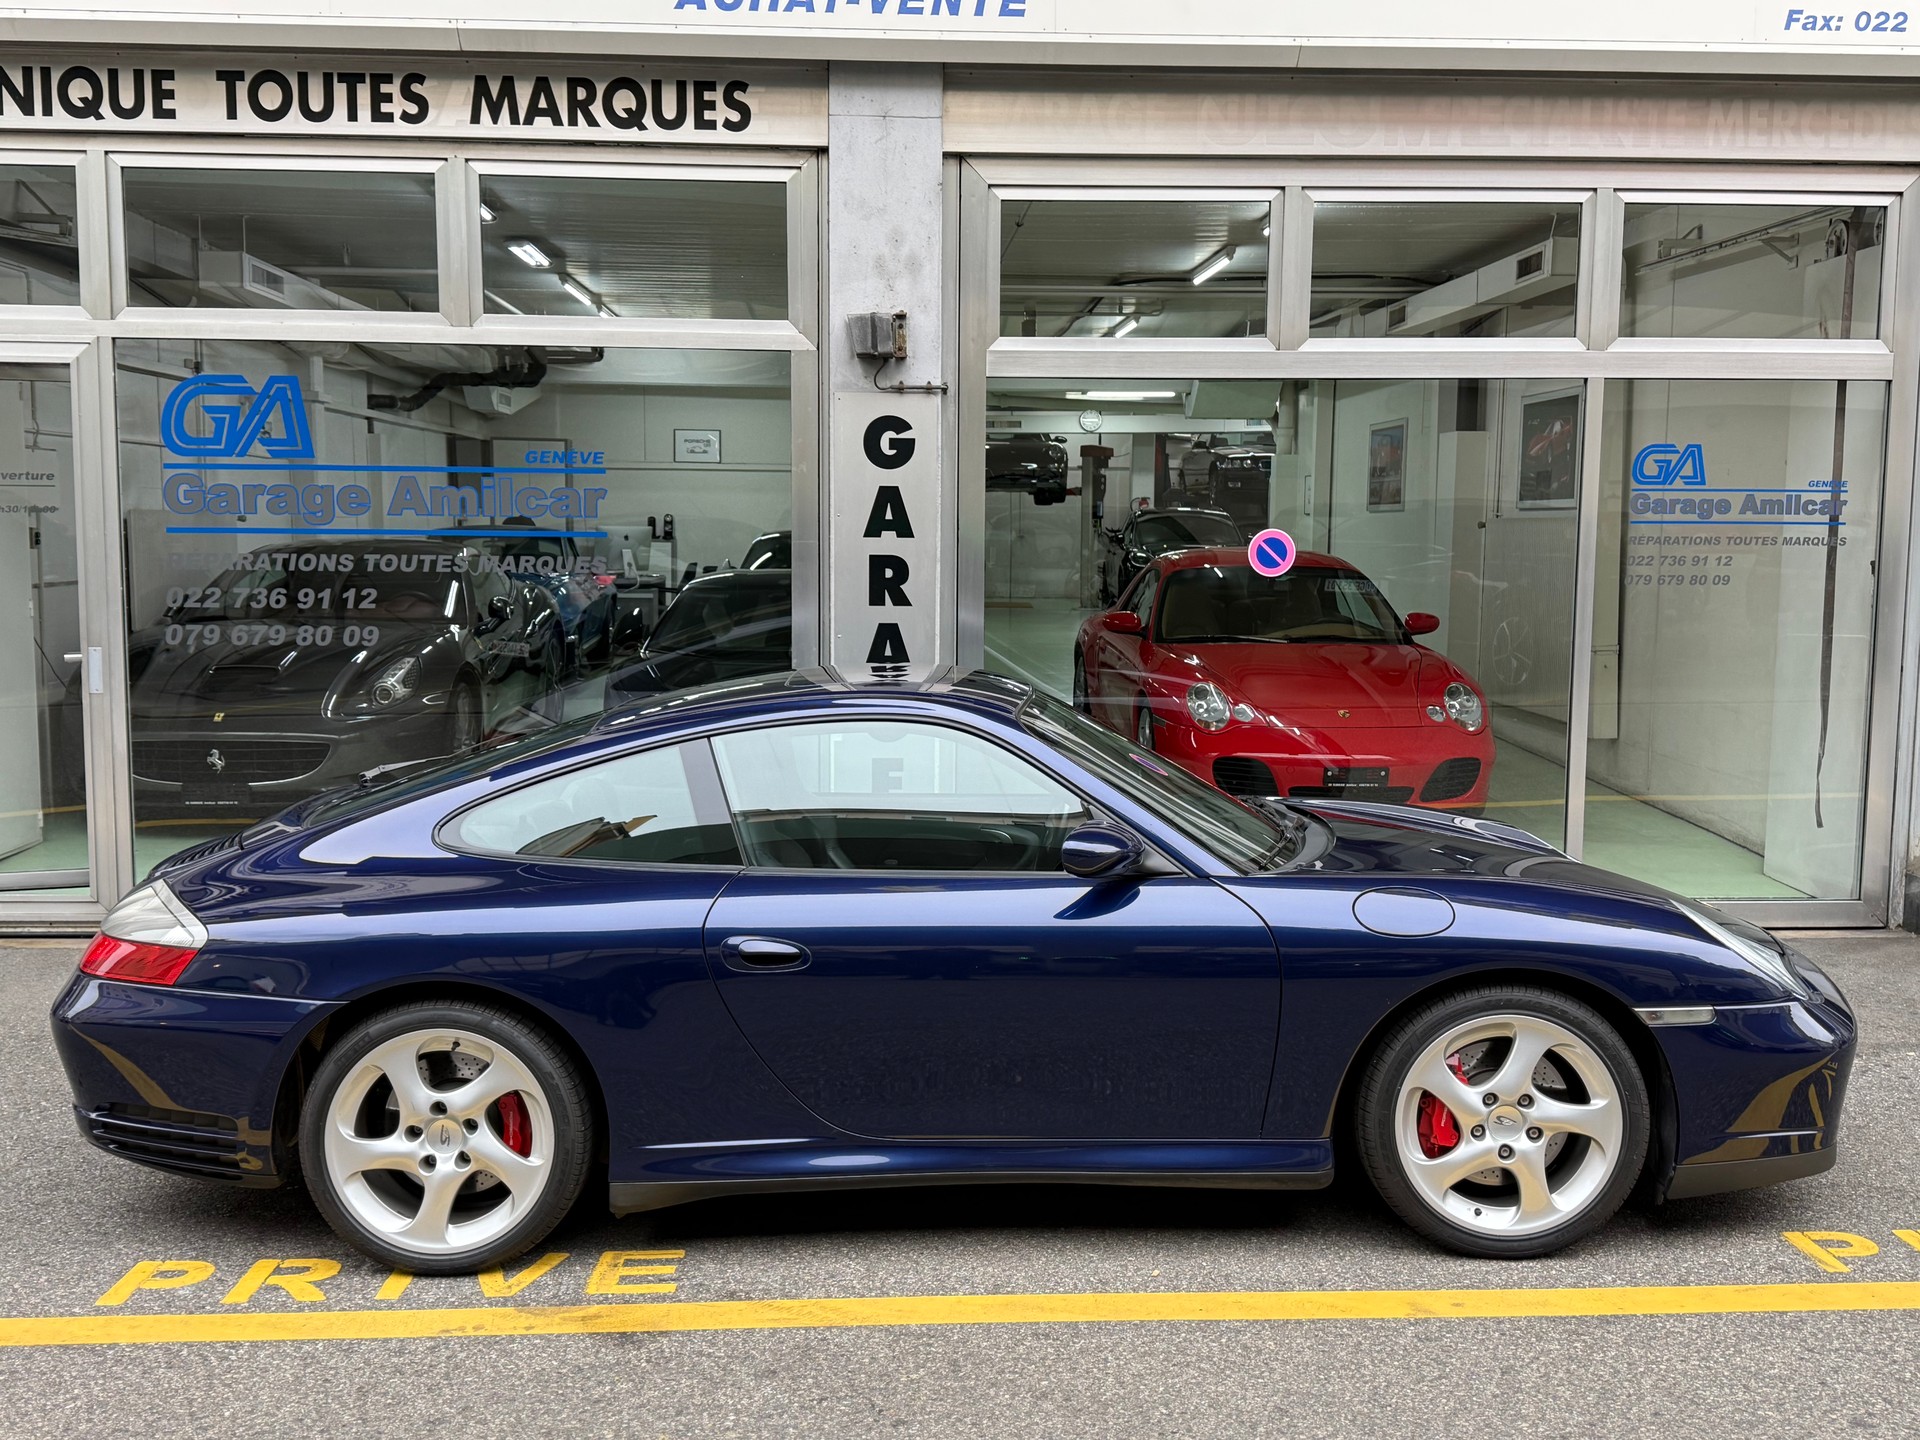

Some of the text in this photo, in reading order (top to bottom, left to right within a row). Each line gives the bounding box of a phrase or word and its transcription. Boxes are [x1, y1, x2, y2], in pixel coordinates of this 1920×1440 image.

[1784, 9, 1908, 32] Fax: 022
[0, 65, 752, 133] NIQUE TOUTES MARQUES
[162, 472, 608, 526] Garage Amilcar
[1630, 493, 1849, 519] Garage Amilcar
[1726, 535, 1779, 546] TOUTES
[1781, 536, 1848, 547] MARQUES
[363, 554, 469, 573] TOUTES
[478, 555, 608, 574] MARQUES
[1627, 555, 1733, 567] 022 736 91 12
[1625, 574, 1731, 586] 079 679 80 09
[166, 586, 378, 609] 022 736 91 12
[165, 624, 380, 647] 079 679 80 09
[95, 1249, 686, 1306] PRIVE
